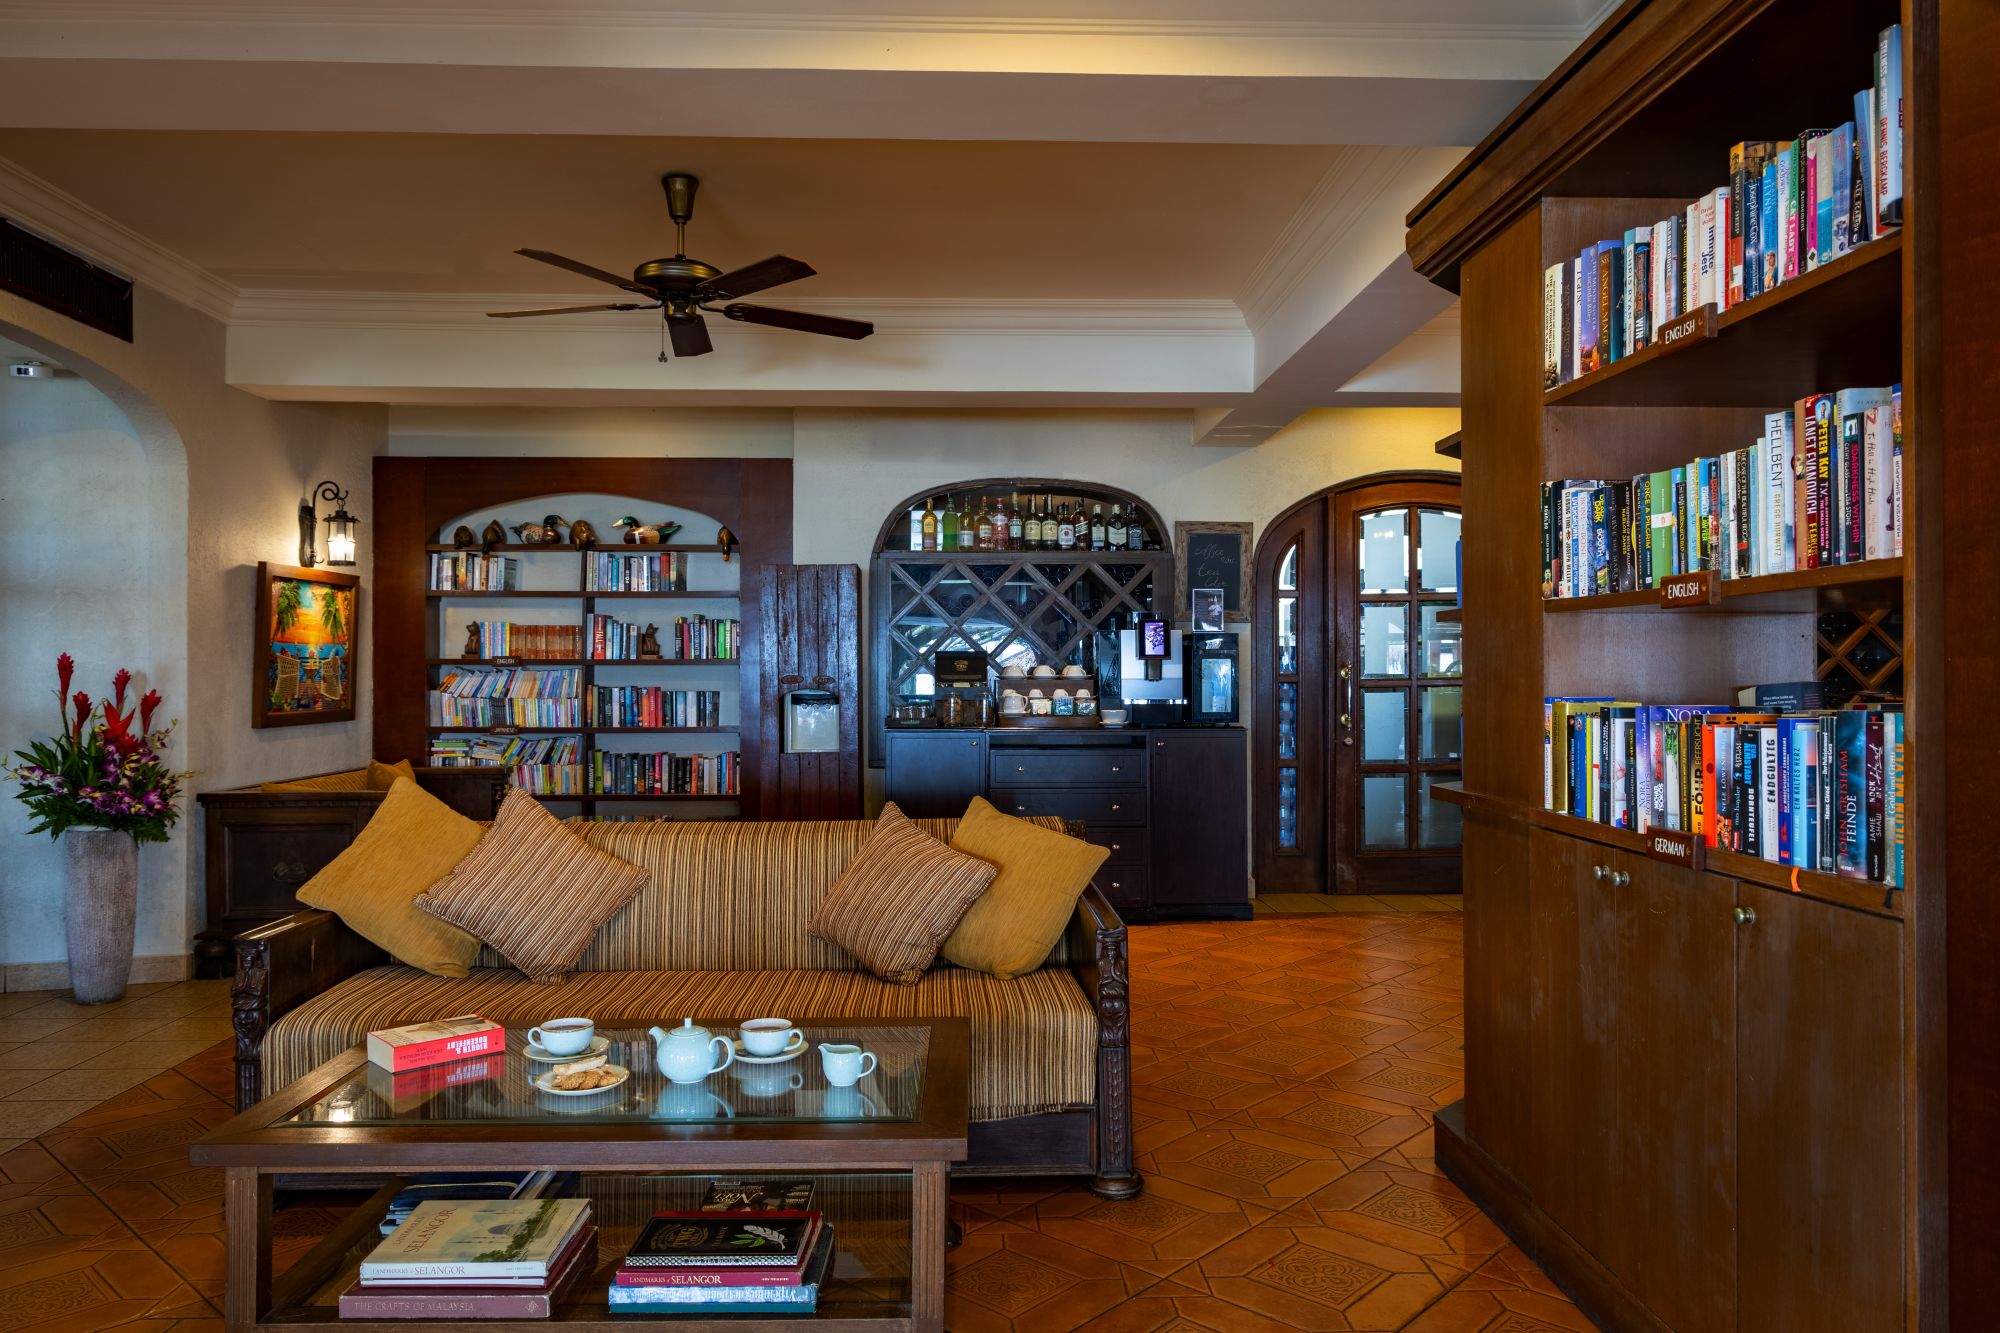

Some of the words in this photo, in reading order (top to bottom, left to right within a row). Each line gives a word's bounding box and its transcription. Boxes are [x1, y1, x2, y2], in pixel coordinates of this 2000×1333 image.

[1880, 118, 1888, 149] DENNIS
[1880, 151, 1888, 196] BERGKAMP
[1746, 184, 1758, 225] Josephine
[1789, 200, 1797, 222] CAT
[1749, 225, 1757, 244] Cox
[1701, 252, 1709, 276] Jest
[1635, 316, 1644, 339] WIN
[1665, 319, 1695, 344] ENGLISH
[1818, 419, 1829, 455] PETER
[1867, 443, 1877, 457] Hell
[1868, 432, 1876, 441] To
[1770, 419, 1783, 489] HELLBENT
[1819, 457, 1829, 478] KAY
[1805, 451, 1816, 515] EVANOVICH
[1851, 446, 1859, 503] DARKNESS
[1866, 467, 1876, 486] High
[1571, 496, 1579, 540] OVERGROWN
[1852, 505, 1860, 543] WITHIN
[1596, 528, 1604, 557] BOOTH
[1667, 582, 1699, 600] ENGLISH
[1694, 718, 1702, 765] EIFERSUCHT
[1744, 743, 1752, 785] ALMSTÄDT
[1867, 743, 1883, 785] Heart
[1692, 768, 1703, 815] FÖHR
[1839, 750, 1848, 814] GRISHAM
[1846, 795, 1856, 843] FEINDE
[1654, 836, 1685, 858] GERMAN
[1839, 818, 1848, 856] JOHN
[447, 1036, 488, 1050] ROSENFELDT
[402, 1207, 457, 1253] SELANGOR
[414, 1266, 465, 1275] SELANGOR
[671, 1275, 722, 1284] SELANGOR
[354, 1302, 372, 1311] THE
[374, 1302, 410, 1311] CRAFTS
[413, 1302, 425, 1311] OF
[427, 1302, 474, 1311] MALAYSIA
